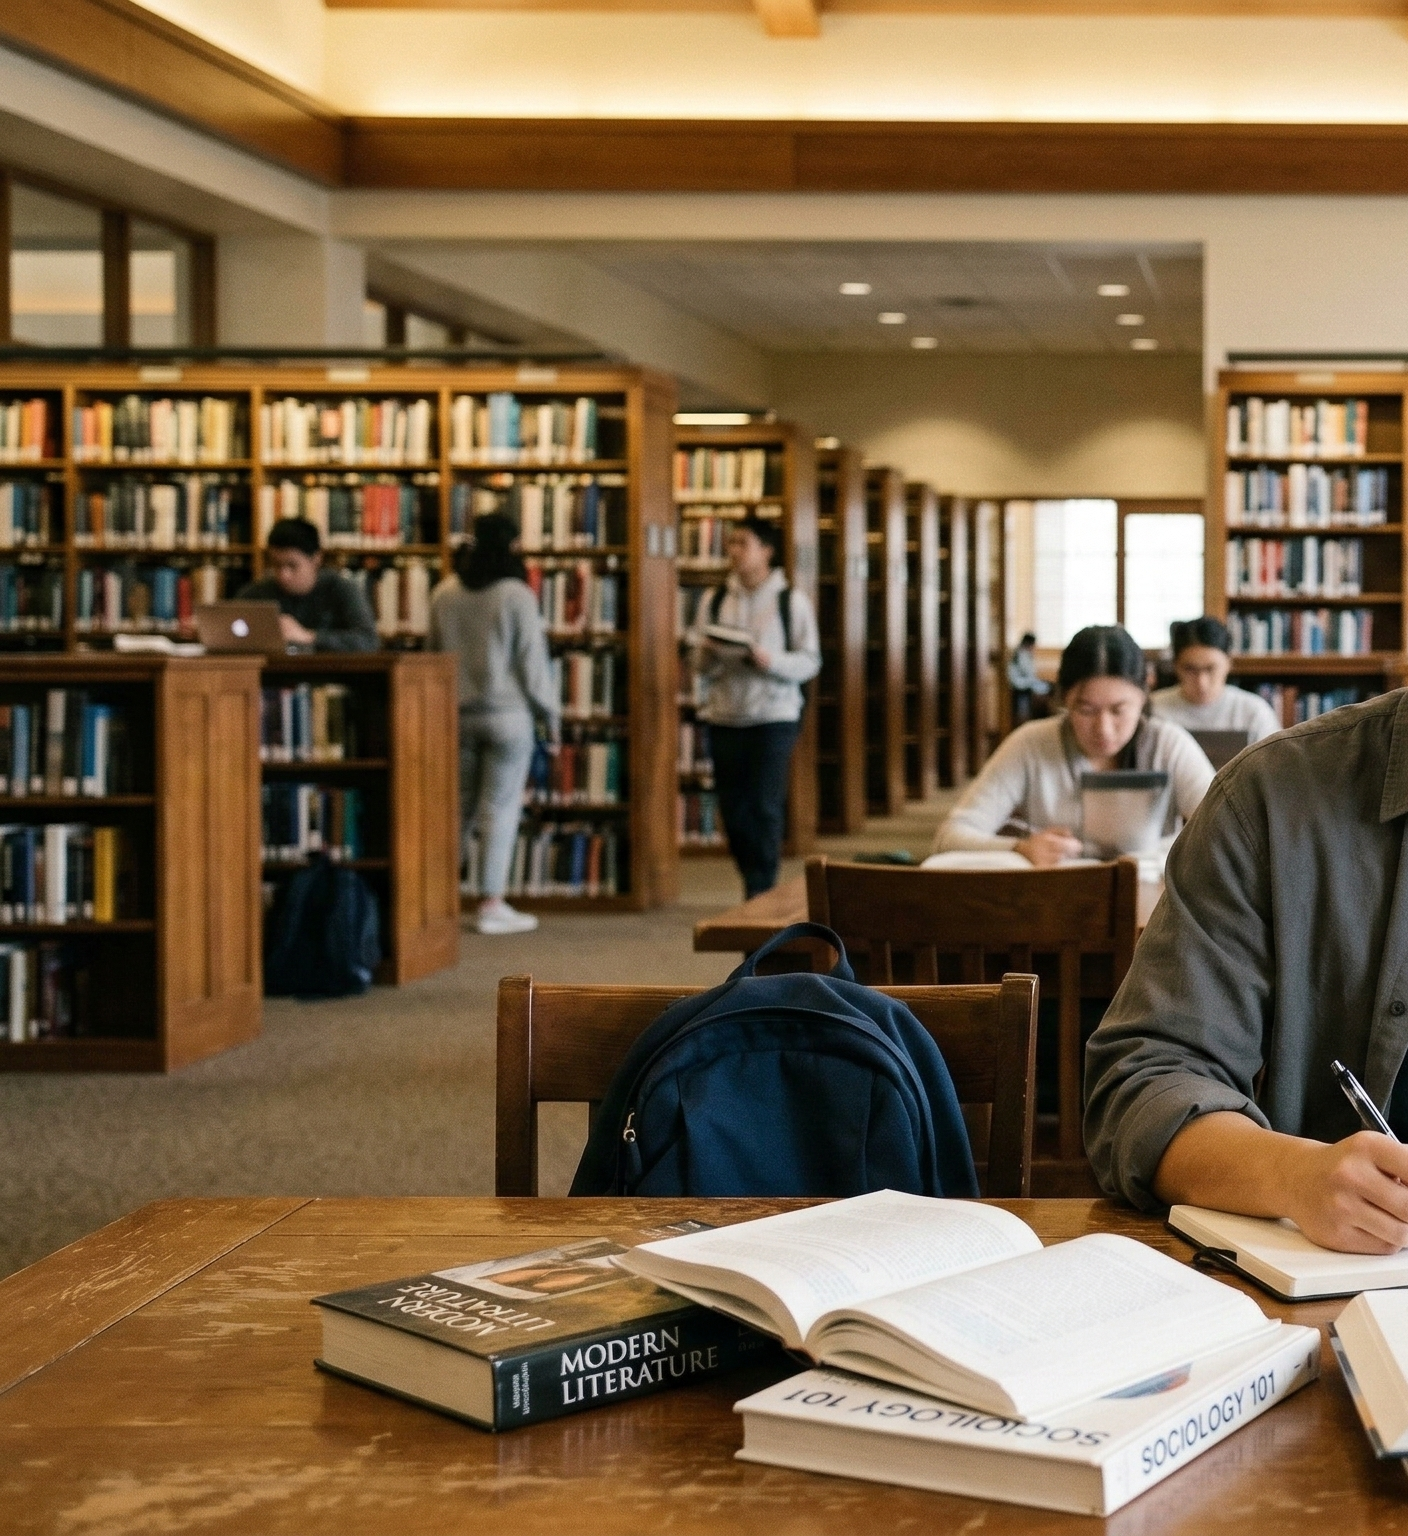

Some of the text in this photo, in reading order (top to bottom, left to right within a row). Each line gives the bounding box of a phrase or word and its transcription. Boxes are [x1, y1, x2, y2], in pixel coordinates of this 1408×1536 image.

[559, 1326, 680, 1377] MODERN
[561, 1345, 719, 1406] LITERATURE
[782, 1388, 849, 1407] 101
[1141, 1369, 1275, 1475] SOCIOLOGY 101
